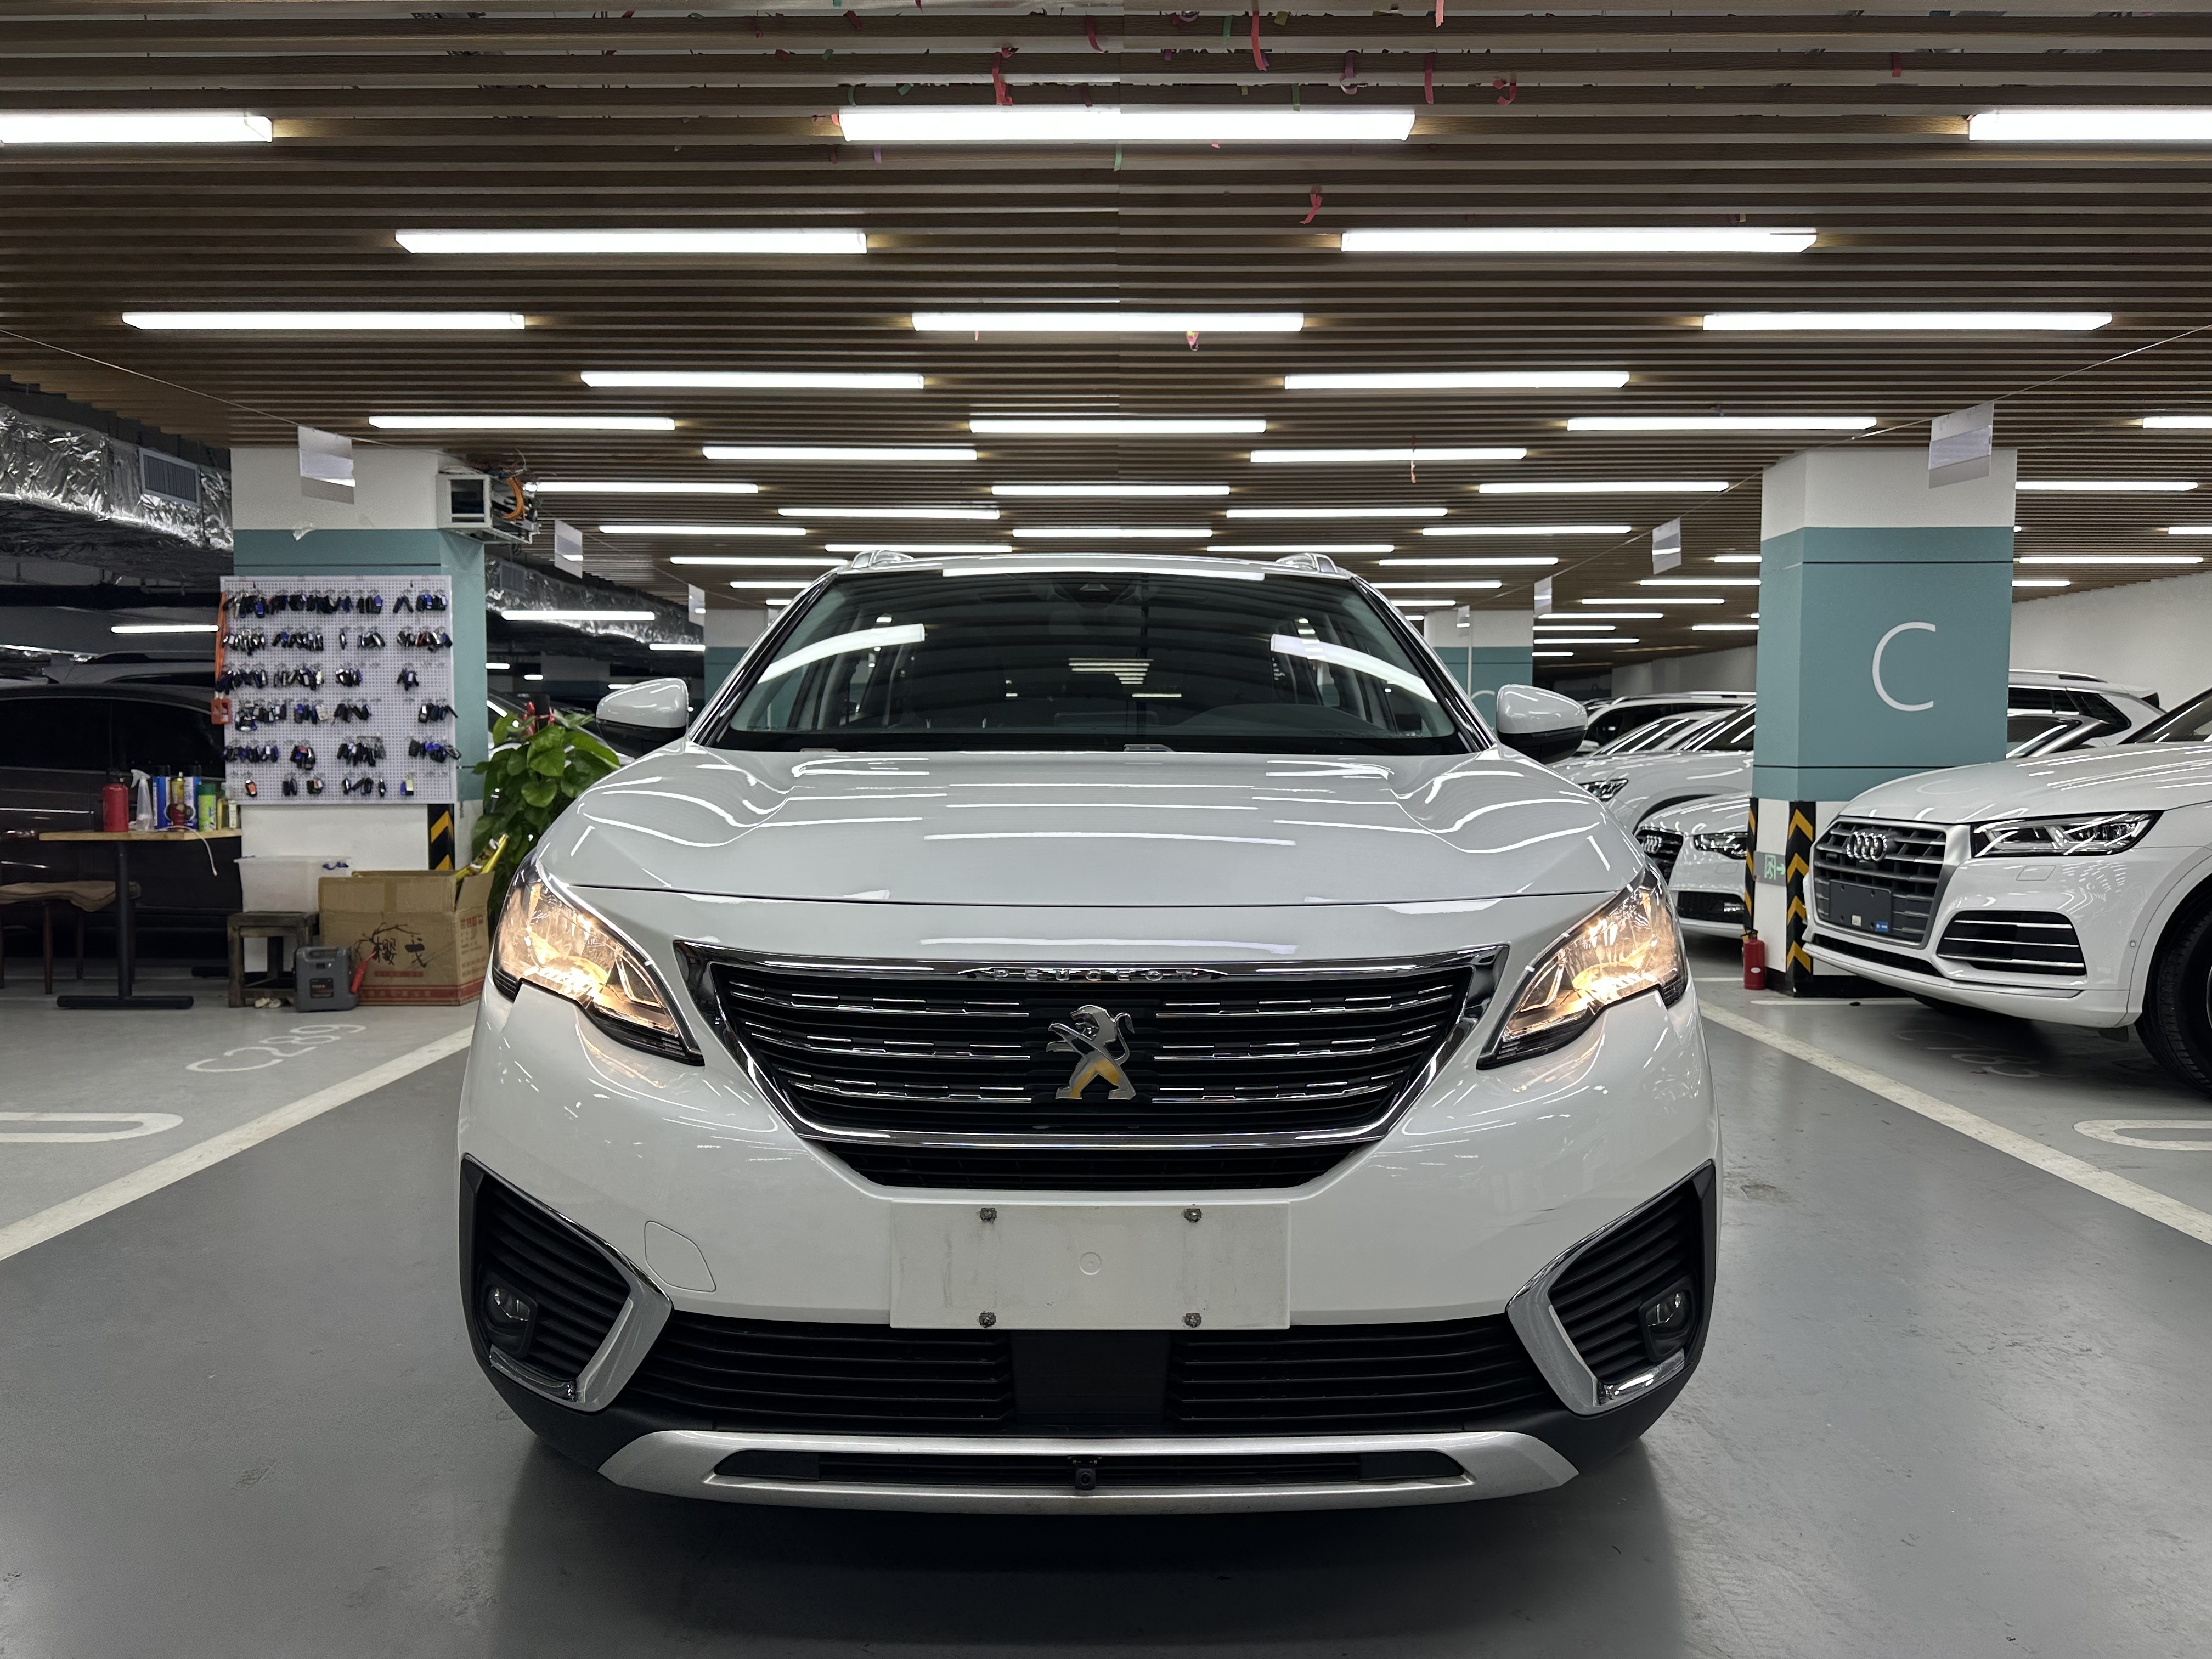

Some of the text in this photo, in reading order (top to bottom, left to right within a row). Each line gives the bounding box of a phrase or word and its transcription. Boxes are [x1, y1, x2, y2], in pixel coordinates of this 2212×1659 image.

[1872, 622, 1936, 712] C
[994, 968, 1194, 981] PEUGEOT
[185, 1024, 366, 1072] C289
